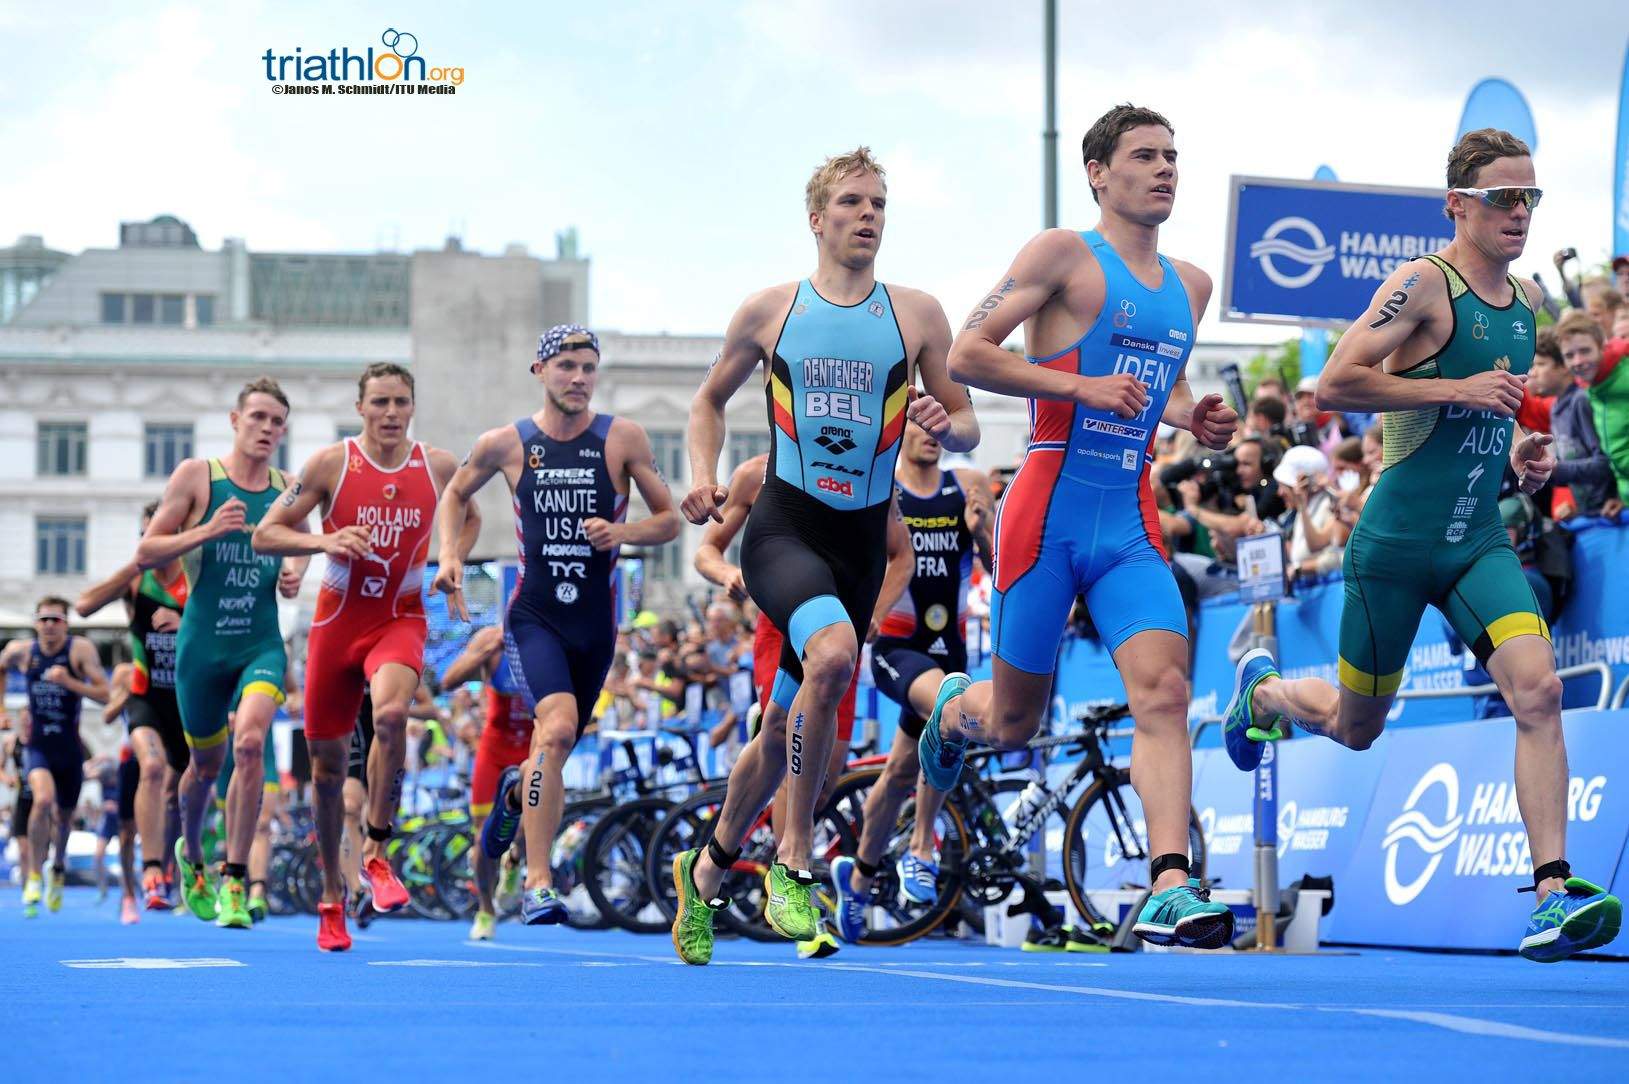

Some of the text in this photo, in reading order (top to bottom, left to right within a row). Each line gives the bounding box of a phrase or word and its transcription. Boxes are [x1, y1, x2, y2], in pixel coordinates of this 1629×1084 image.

[1340, 231, 1452, 257] HAMBUR
[1340, 254, 1400, 280] WAS
[1122, 338, 1156, 352] Danske
[803, 357, 874, 395] DENTENEER
[1112, 353, 1172, 392] IDEN
[805, 391, 873, 426] BEL
[820, 425, 854, 439] arena
[1096, 421, 1146, 439] INTERSPORT
[1458, 426, 1506, 456] AUS
[533, 467, 596, 480] TREK
[533, 489, 598, 514] KANUTE
[356, 505, 421, 529] HOLLAUS
[546, 517, 591, 541] USA
[368, 524, 404, 549] AUT
[912, 531, 960, 552] ONINX
[224, 567, 261, 589] AUS
[548, 561, 587, 579] TYR
[916, 555, 949, 578] FRA
[791, 732, 803, 776] 59
[528, 769, 544, 808] 29
[1466, 776, 1608, 826] HAMRG
[1454, 831, 1535, 877] WASSE
